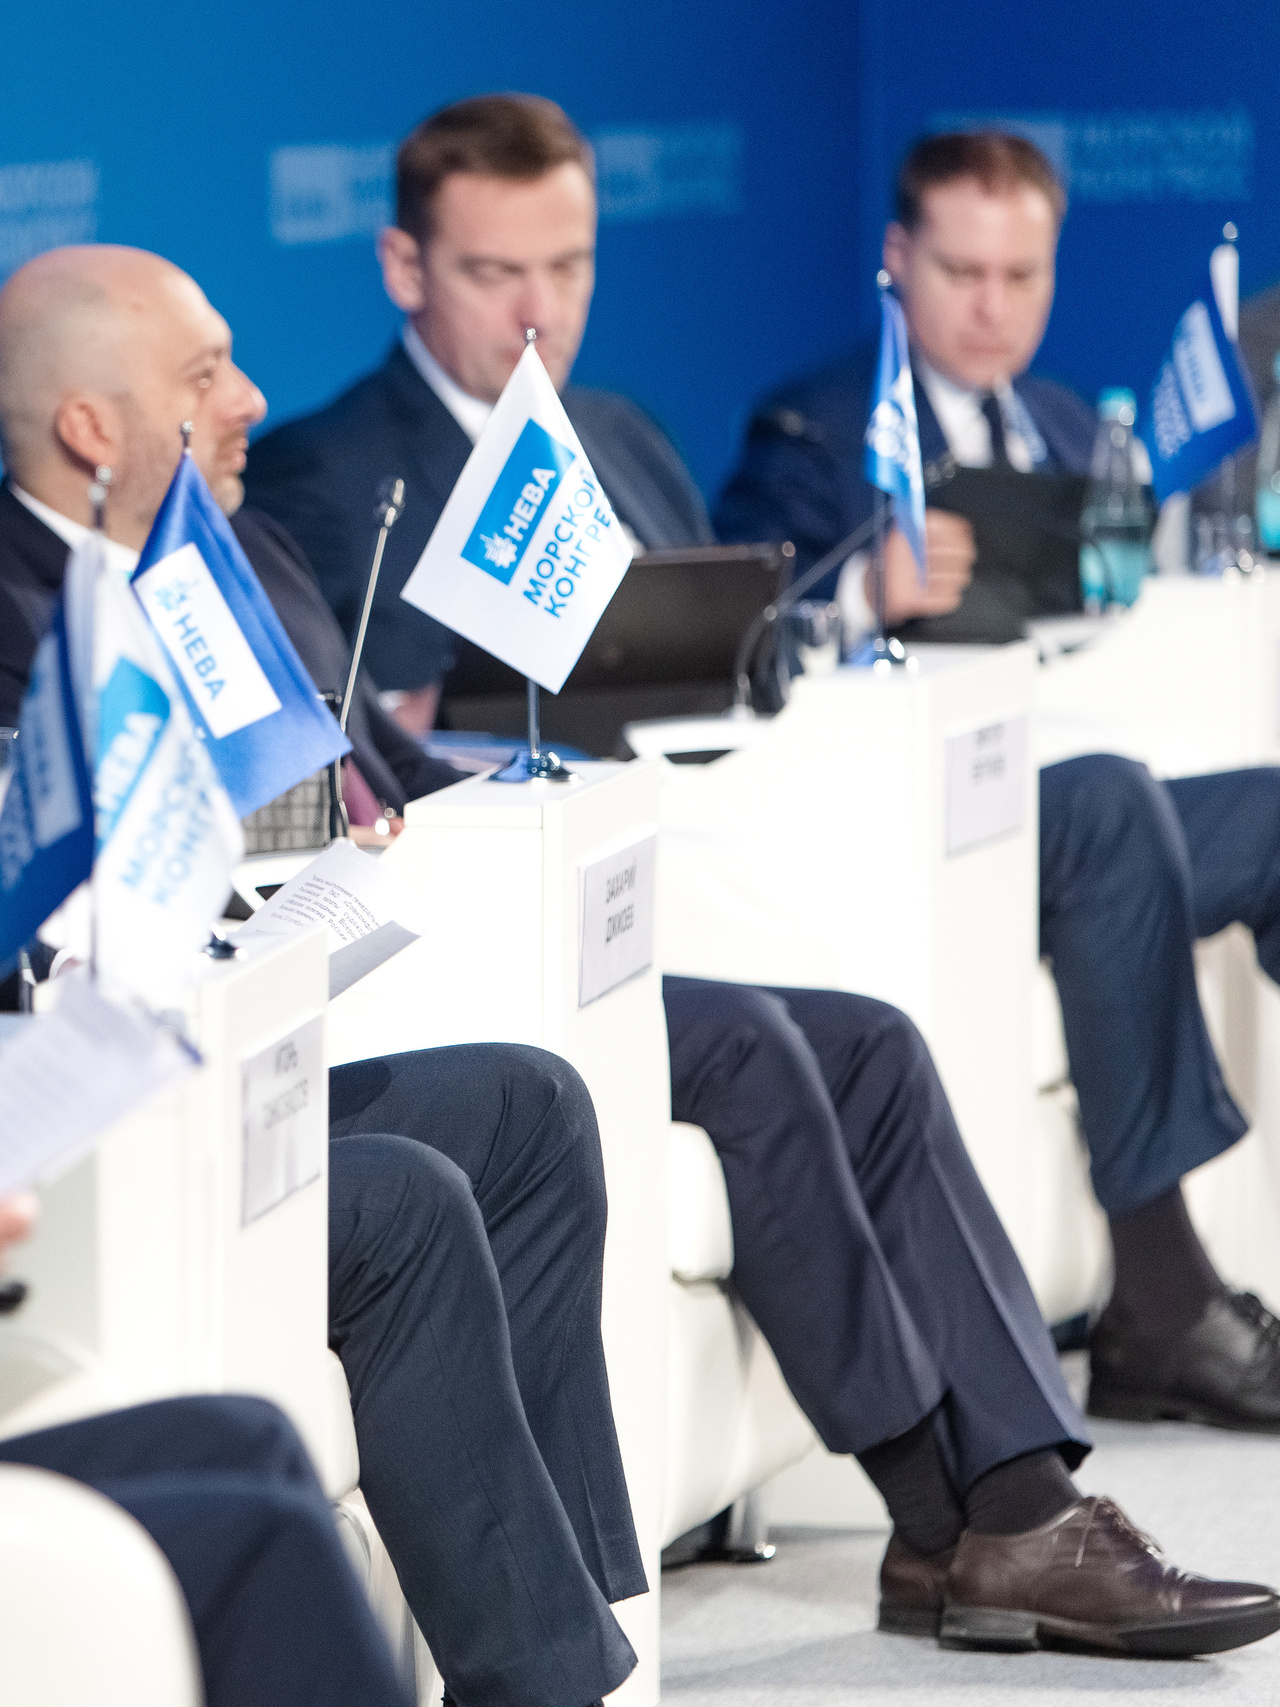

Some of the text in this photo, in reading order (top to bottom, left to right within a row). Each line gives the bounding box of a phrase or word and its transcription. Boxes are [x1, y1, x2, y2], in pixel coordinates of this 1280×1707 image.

[503, 467, 557, 541] НЕВА
[544, 497, 614, 619] КОНГРЕ
[173, 612, 226, 701] НЕВА
[328, 919, 347, 941] России
